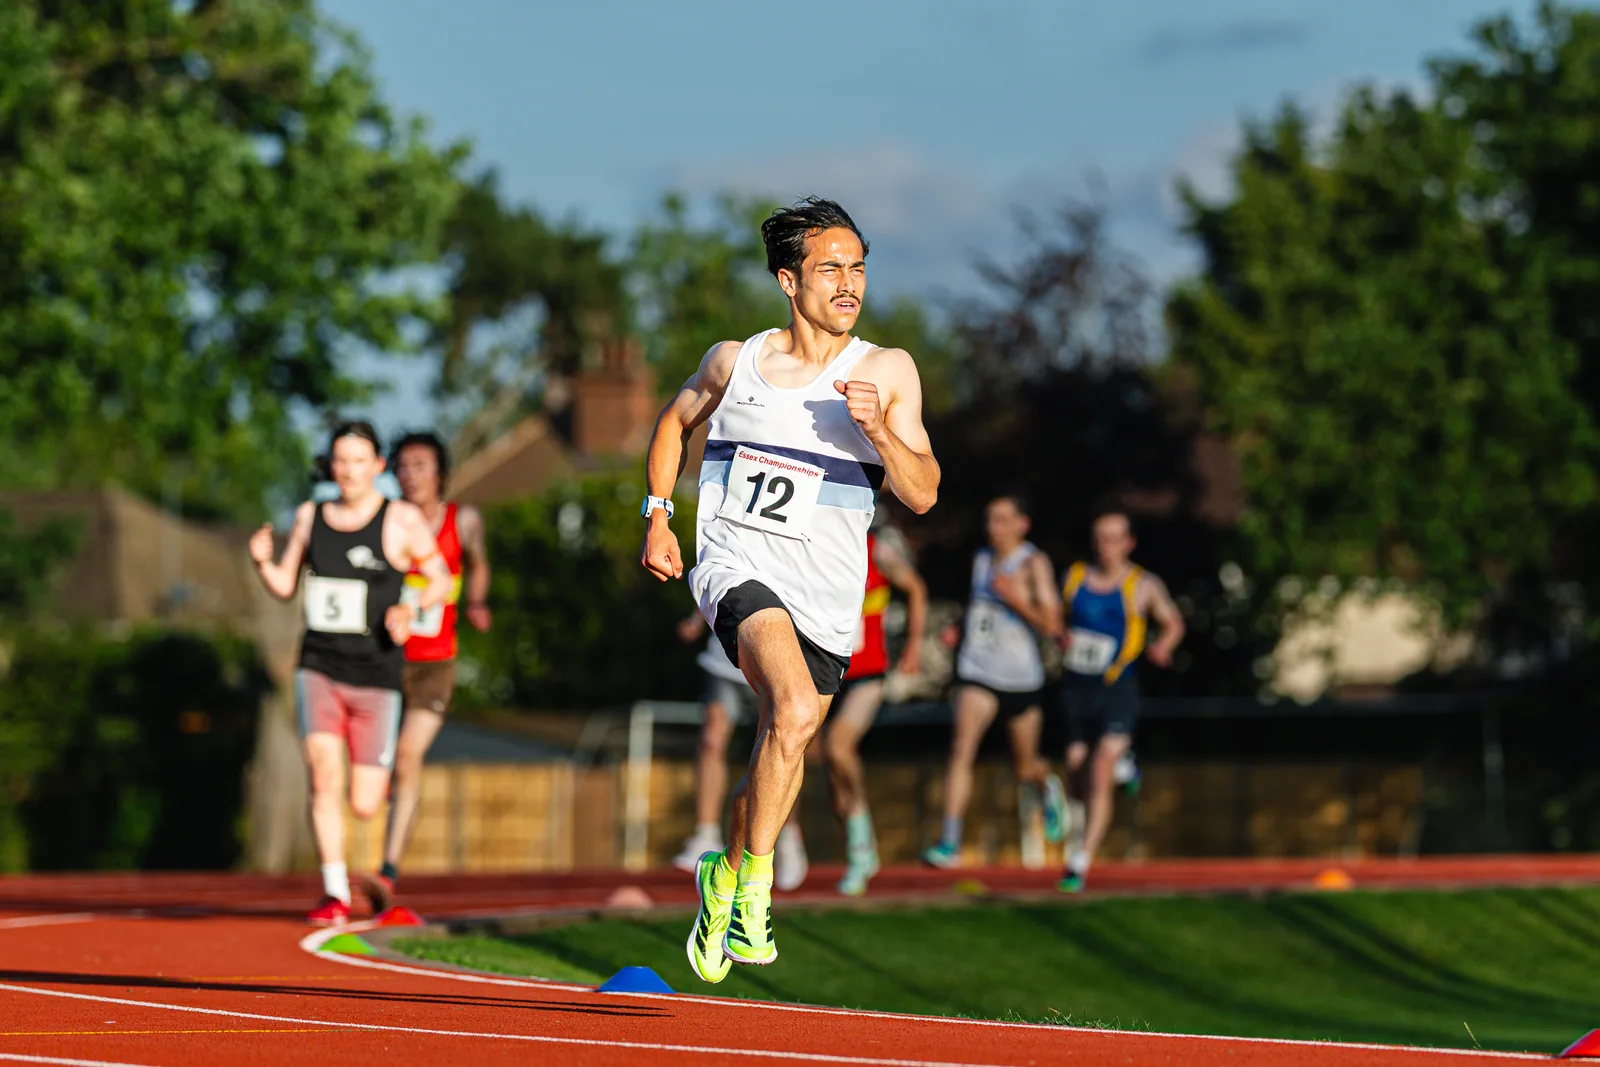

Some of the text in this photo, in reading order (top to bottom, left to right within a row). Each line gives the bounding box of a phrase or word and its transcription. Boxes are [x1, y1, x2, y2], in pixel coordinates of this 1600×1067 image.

[738, 450, 819, 478] Essex Championships
[746, 471, 795, 523] 12
